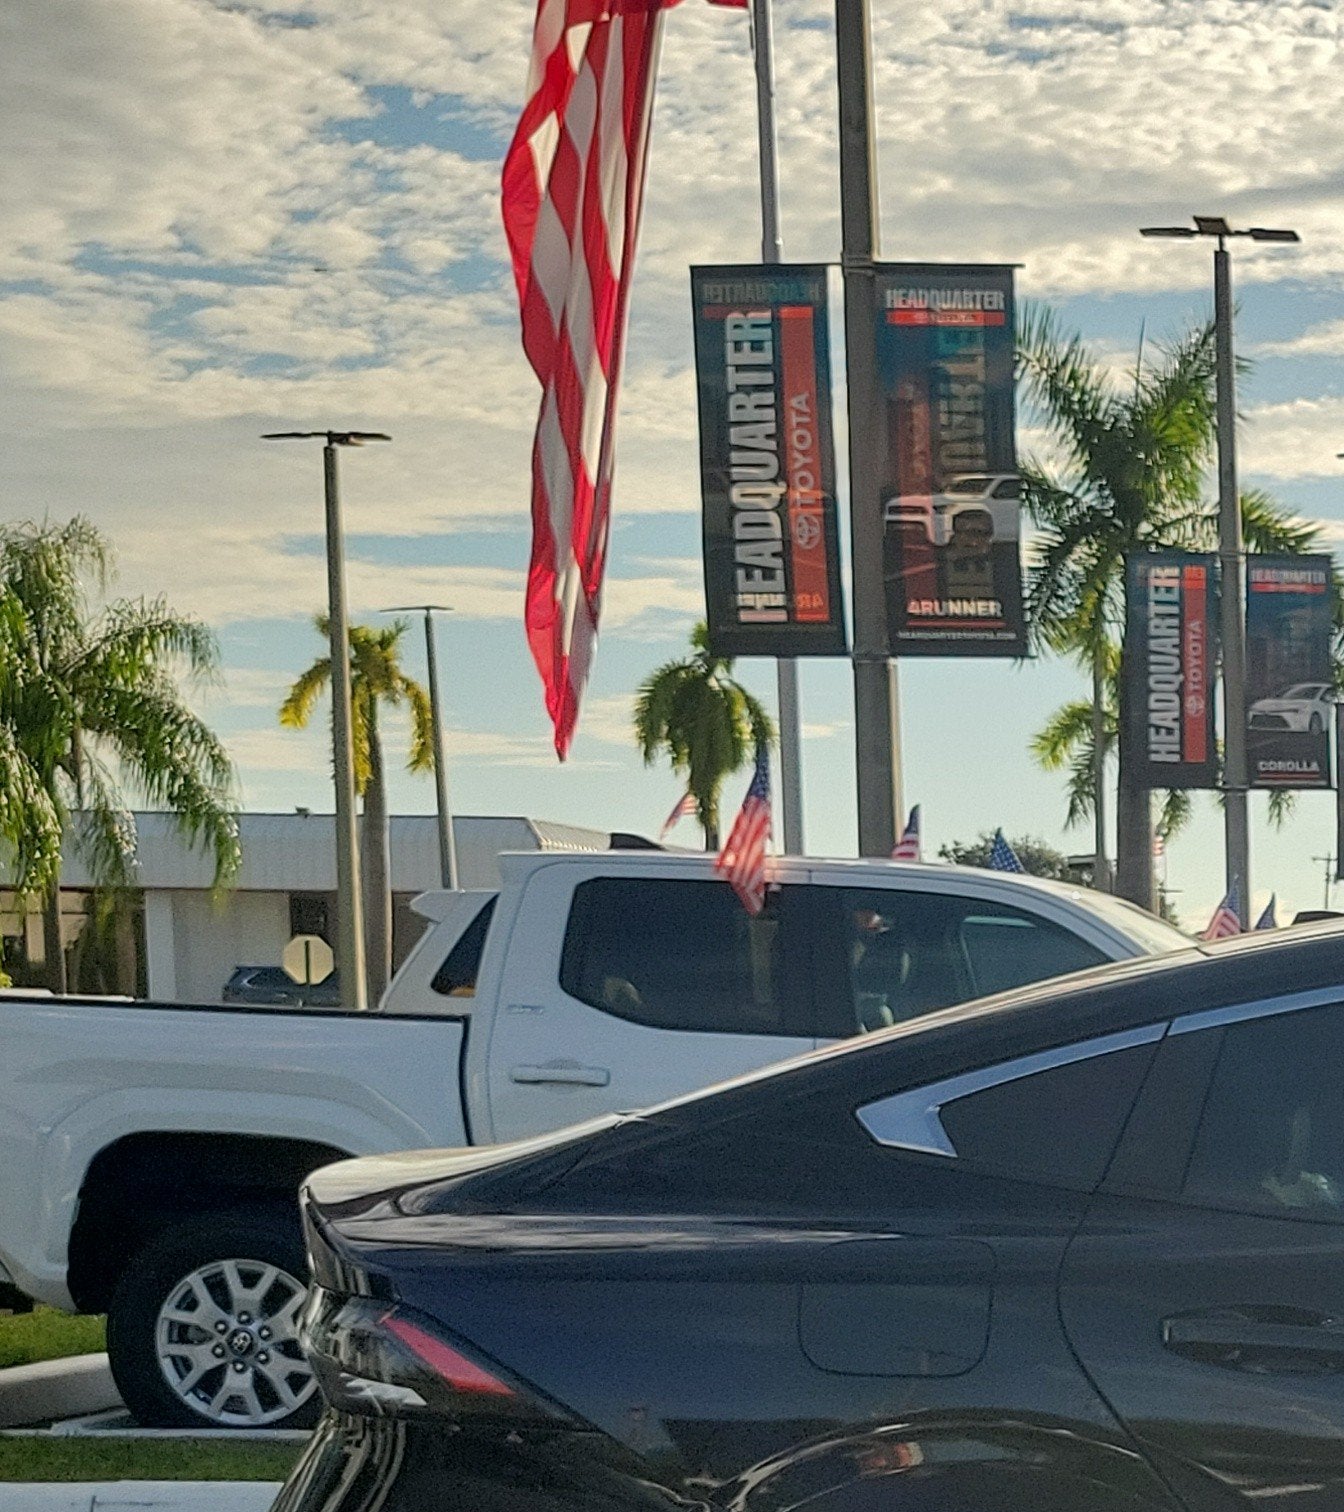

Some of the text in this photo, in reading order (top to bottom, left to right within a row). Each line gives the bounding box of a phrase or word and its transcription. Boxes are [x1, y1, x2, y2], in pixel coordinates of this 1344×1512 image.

[886, 288, 1004, 310] HEADQUARTER
[724, 310, 789, 623] HEADQUARTER
[788, 392, 815, 507] TOYOTA
[906, 598, 1003, 617] 4RUNNER
[1147, 566, 1183, 763] HEADQUARTER
[1187, 620, 1202, 692] TOYOTA
[1257, 760, 1320, 772] COROLLA
